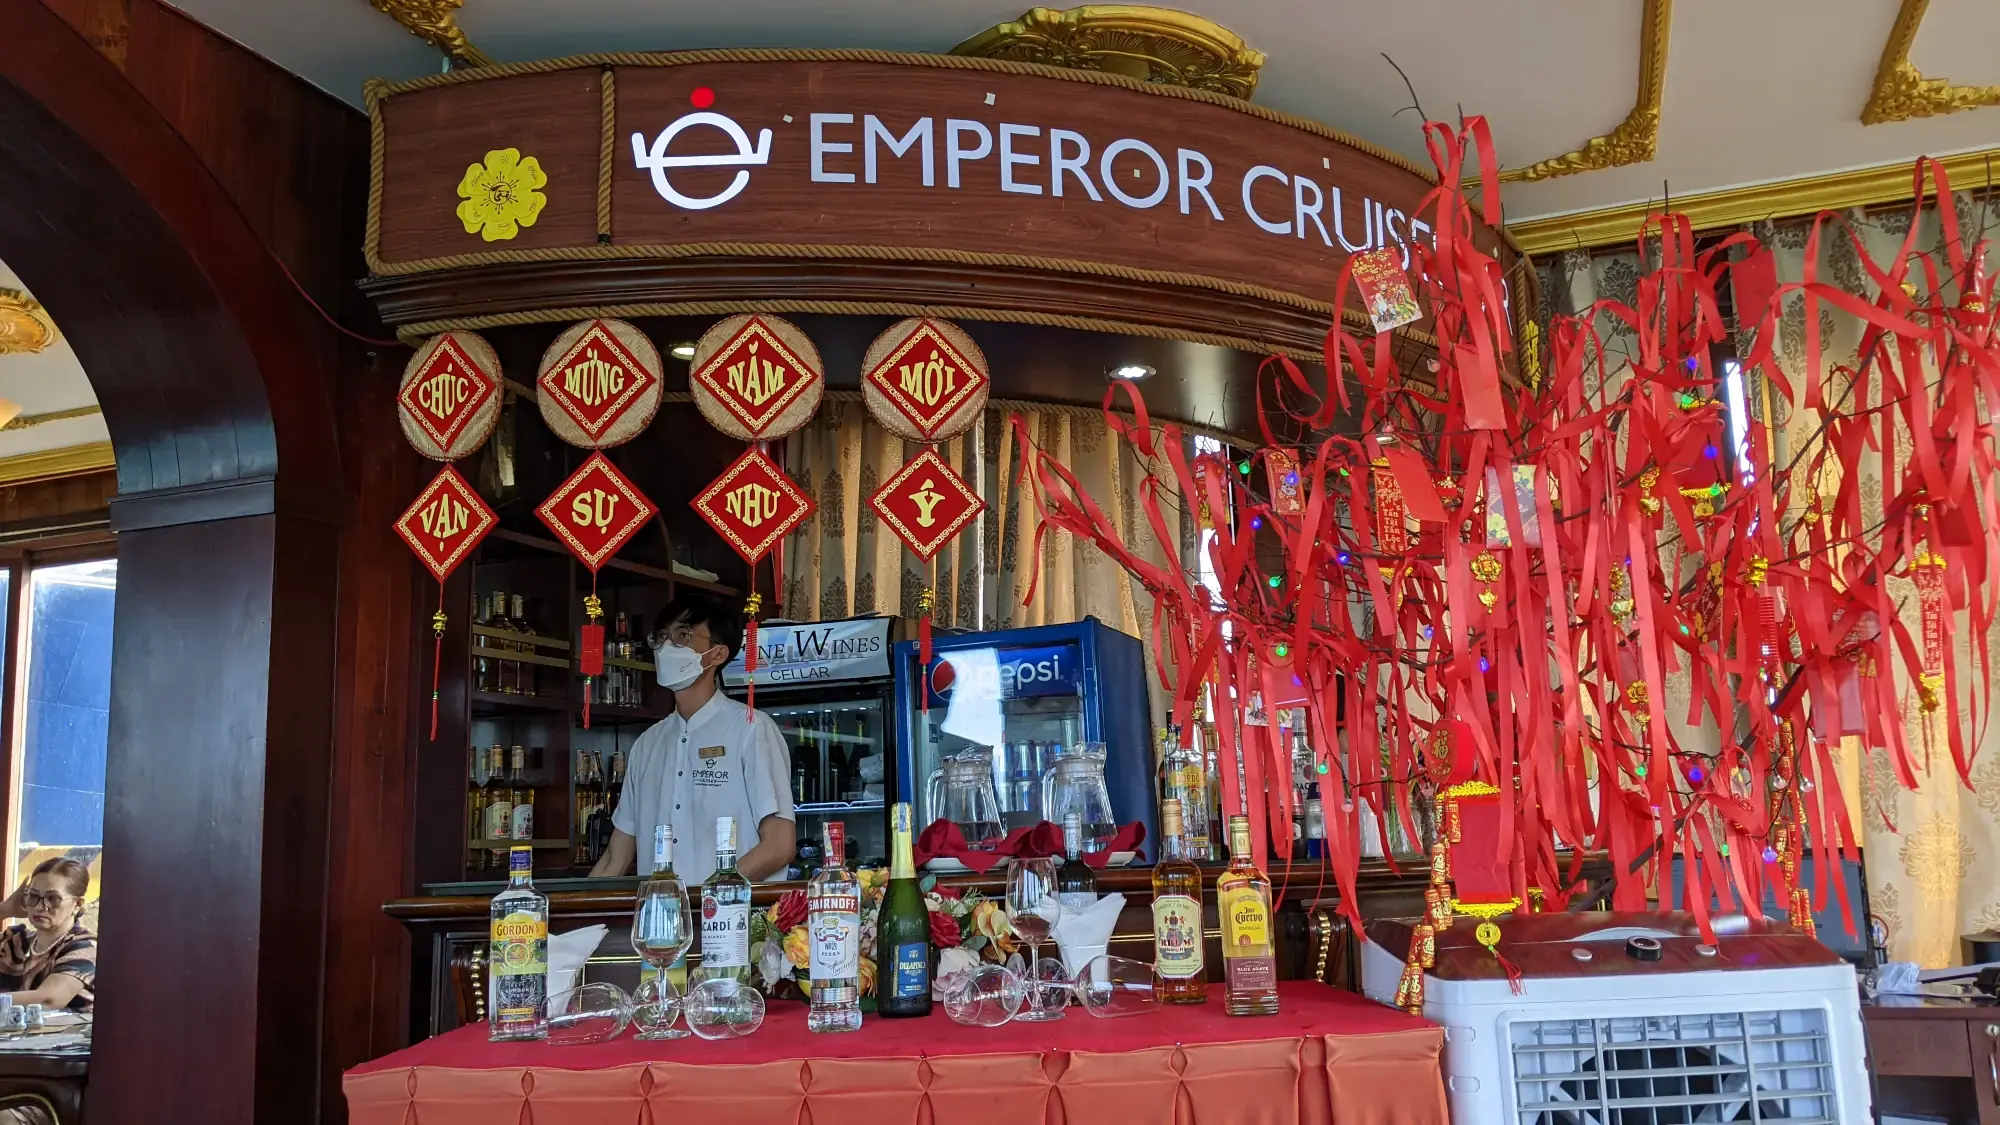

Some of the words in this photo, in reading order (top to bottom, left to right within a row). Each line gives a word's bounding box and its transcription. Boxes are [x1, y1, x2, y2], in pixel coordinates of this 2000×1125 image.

[810, 113, 1224, 221] EMPEROR
[418, 362, 469, 420] CHÚC
[563, 347, 625, 407] MỪNG
[726, 340, 786, 407] NĂM
[899, 349, 956, 407] MỚI
[419, 493, 470, 552] VẠN
[571, 488, 620, 535] SỰ
[725, 482, 781, 528] NHƯ
[909, 478, 946, 528] Ý
[793, 627, 880, 658] WINES
[770, 666, 830, 682] CELLAR
[692, 769, 729, 780] EMPEROR
[1235, 911, 1263, 925] Cuervo
